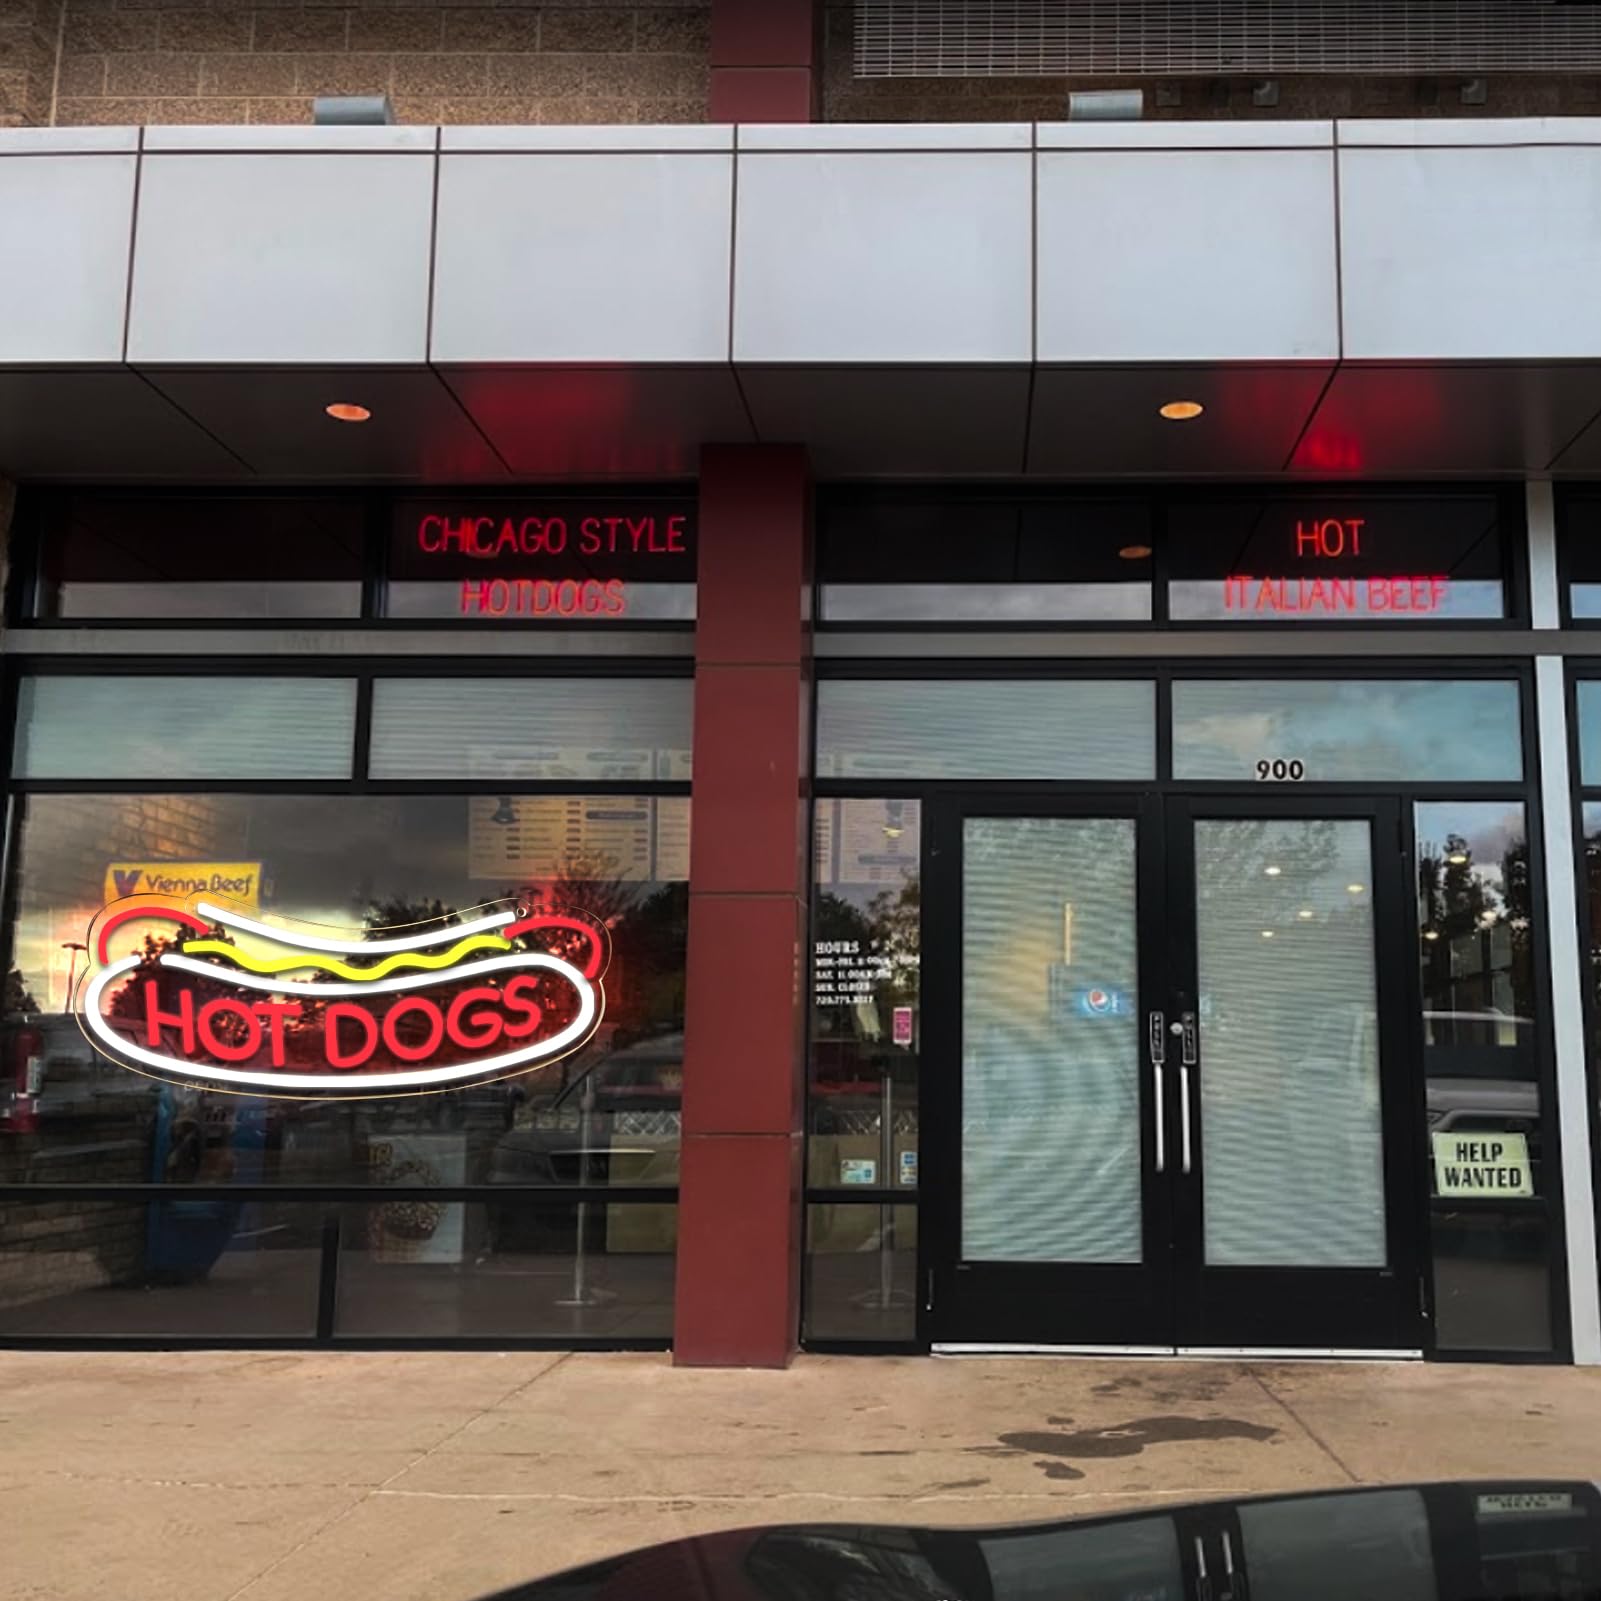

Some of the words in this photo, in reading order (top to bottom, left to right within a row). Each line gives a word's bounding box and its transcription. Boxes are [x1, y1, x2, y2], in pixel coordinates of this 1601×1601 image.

[417, 515, 568, 553] CHICAGO
[579, 516, 687, 554] STYLE
[1295, 519, 1366, 557] HOT
[461, 578, 626, 617] HOTDOGS
[1222, 575, 1358, 613] ITALIAN
[1366, 575, 1451, 613] BEEF
[1257, 759, 1304, 780] 900
[145, 873, 208, 893] Vienna
[209, 872, 254, 897] Beef
[815, 940, 860, 954] HOURS
[144, 980, 301, 1068] HOT
[325, 975, 542, 1068] DOGS
[1455, 1142, 1503, 1163] HELP
[1443, 1166, 1522, 1189] WANTED
